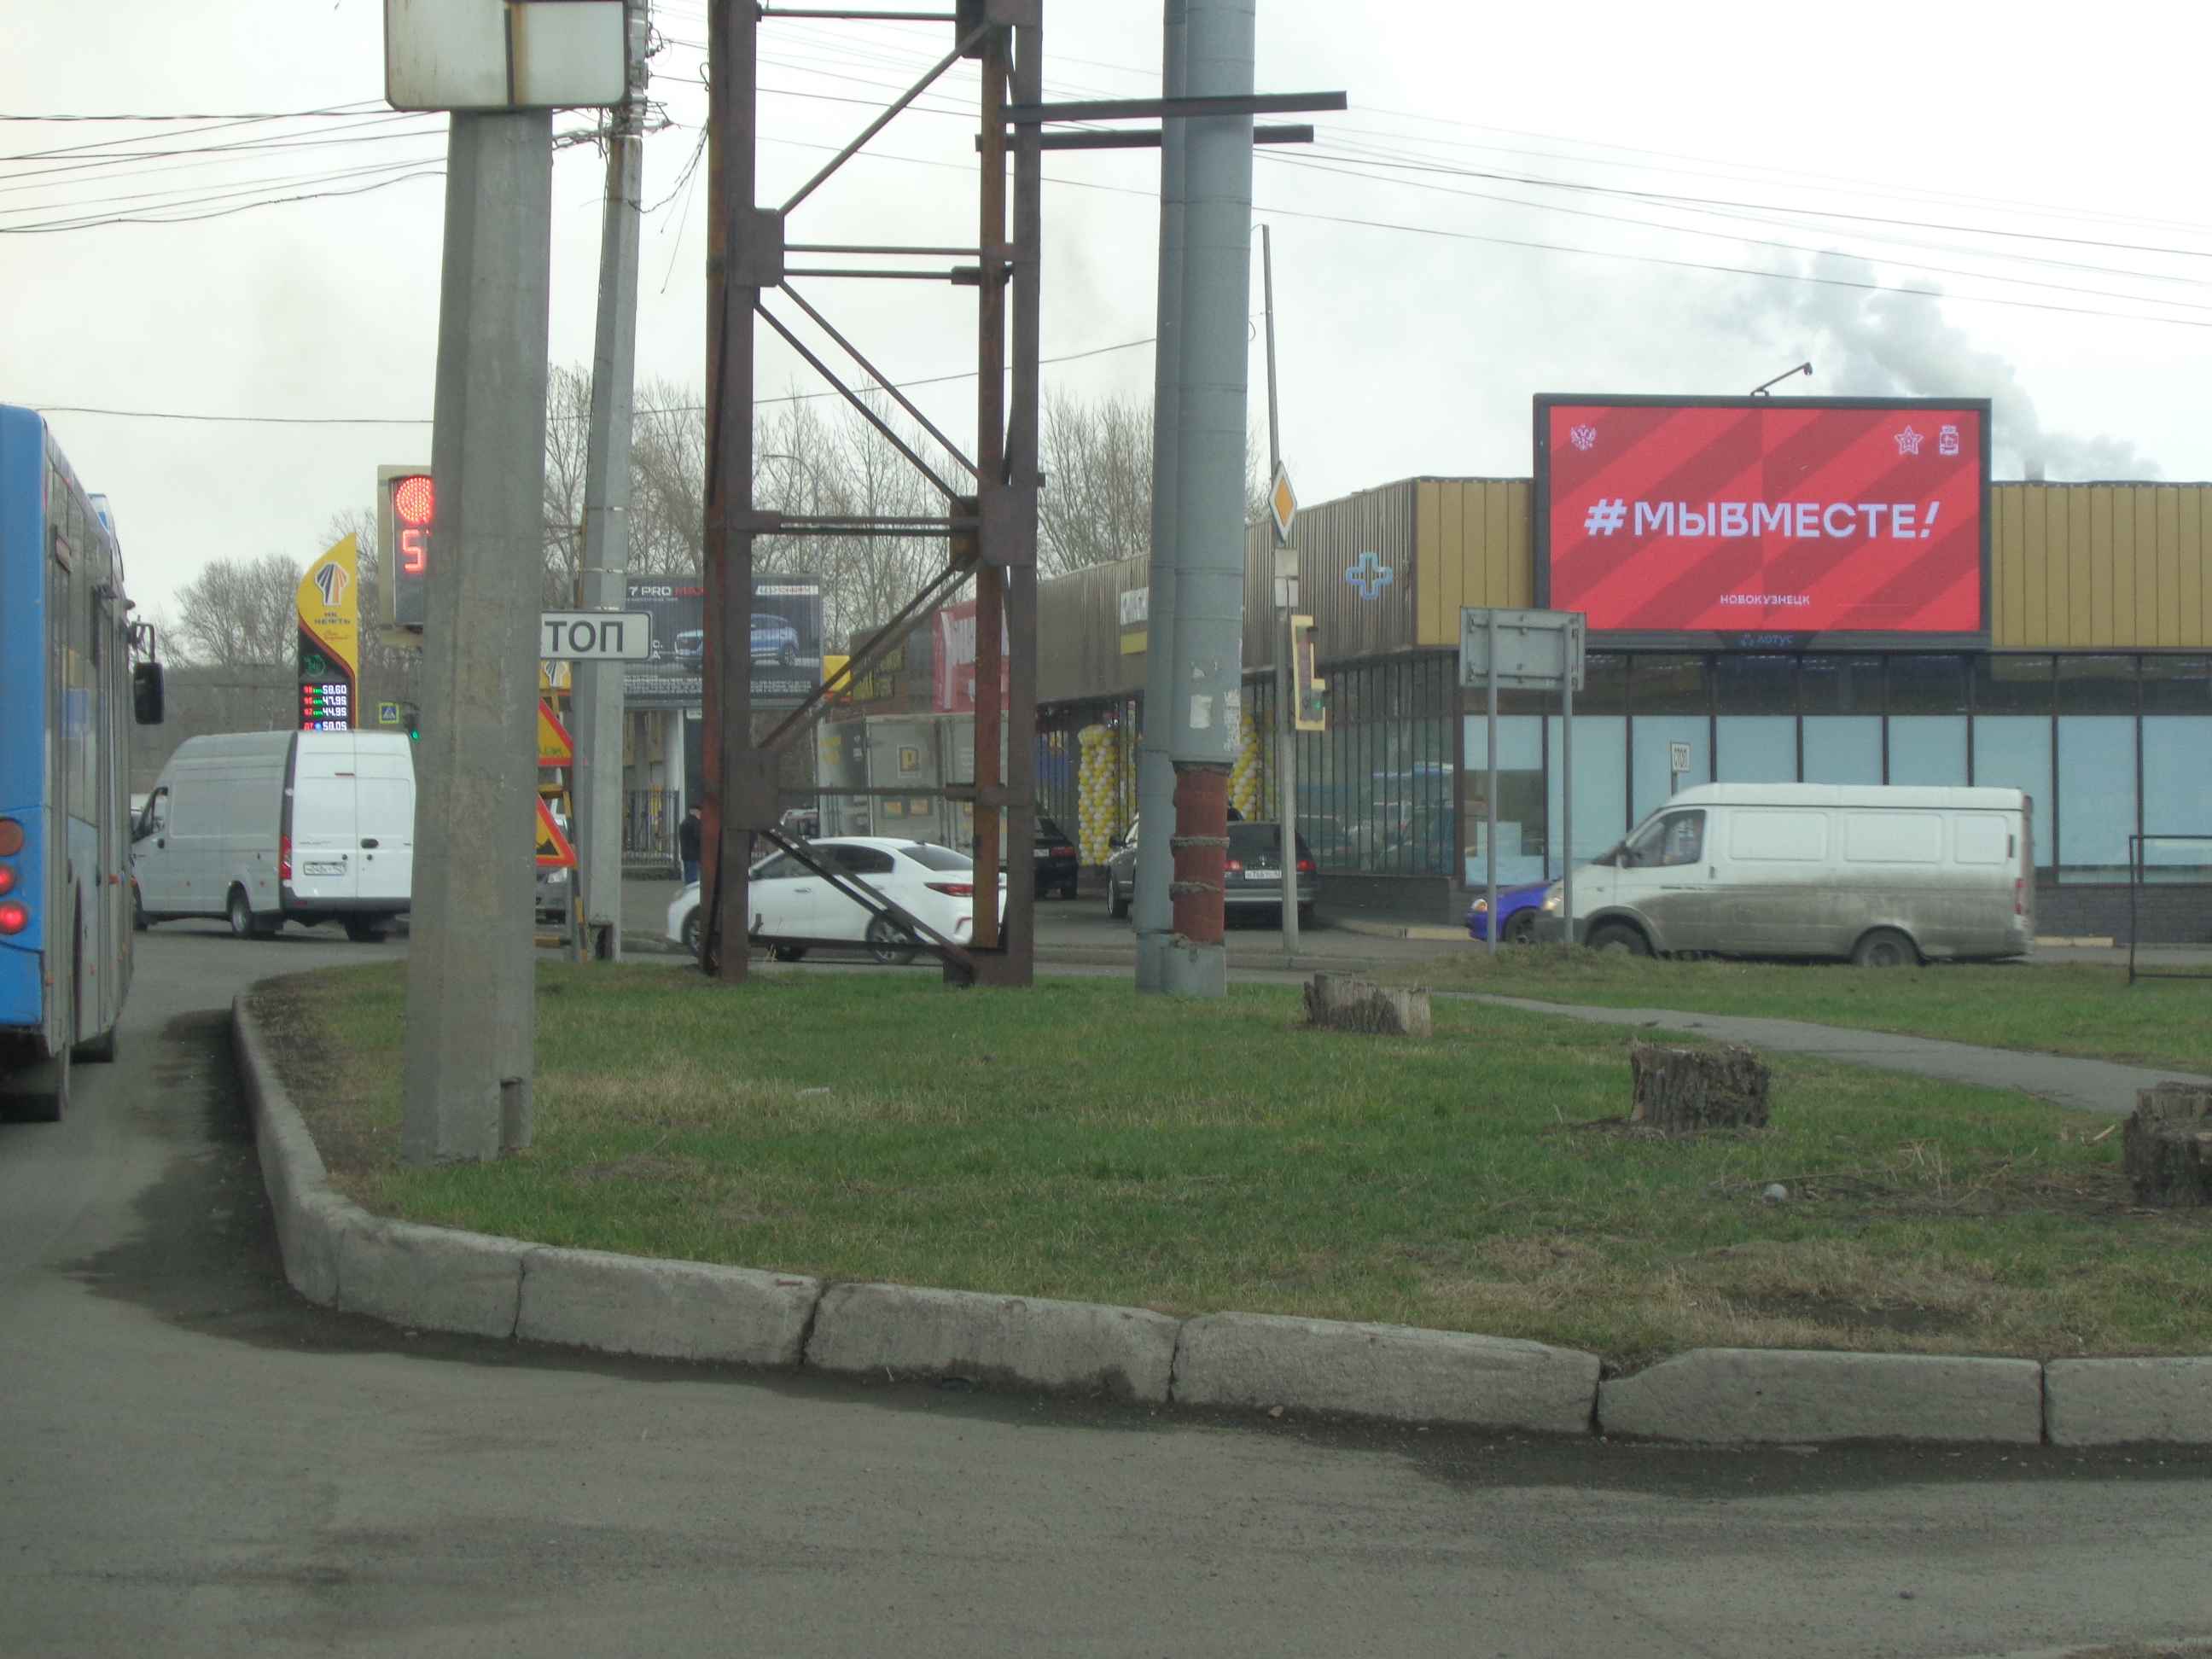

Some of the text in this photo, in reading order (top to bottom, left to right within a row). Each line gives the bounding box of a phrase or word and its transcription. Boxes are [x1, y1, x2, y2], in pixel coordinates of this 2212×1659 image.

[1584, 498, 1940, 538] #МЫВМЕСТЕ!
[402, 529, 430, 570] 5
[641, 586, 672, 596] PRO
[1720, 594, 1810, 606] НОВОКУЗНЕЦК
[544, 620, 624, 653] ТОП
